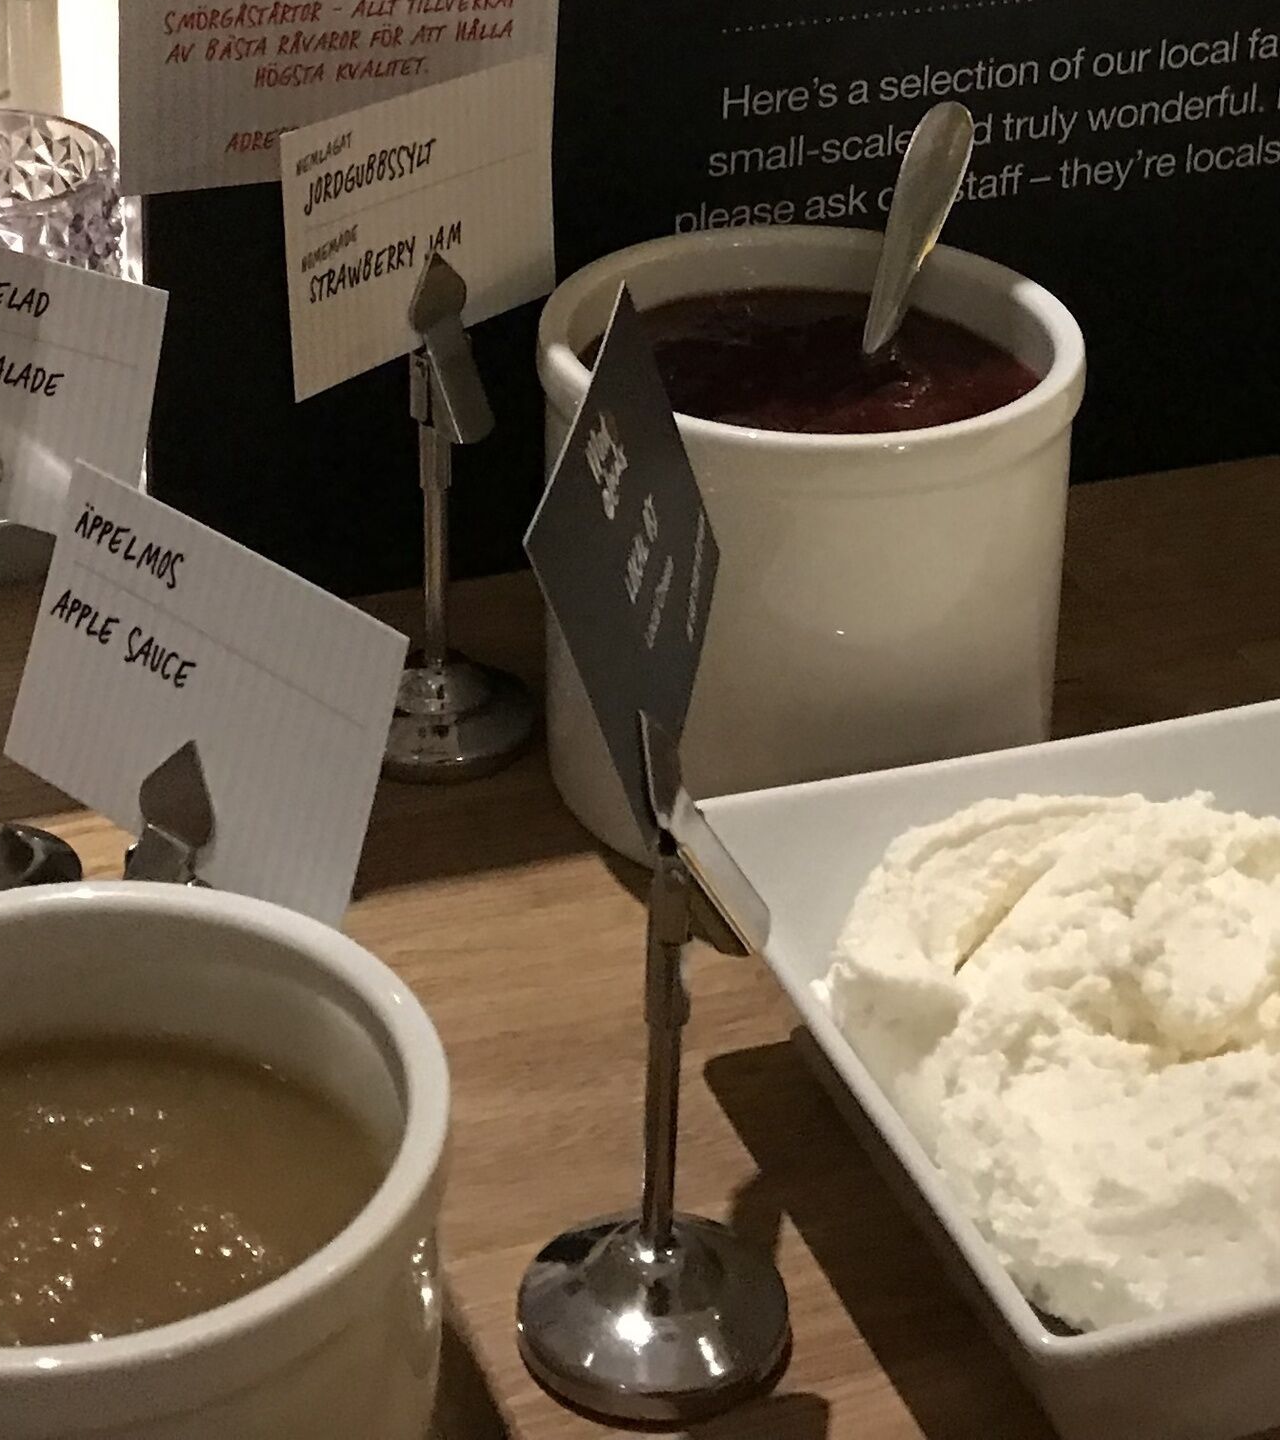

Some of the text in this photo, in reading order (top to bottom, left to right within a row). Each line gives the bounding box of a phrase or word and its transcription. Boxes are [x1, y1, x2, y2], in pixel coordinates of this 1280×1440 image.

[164, 1, 322, 35] SMÖRGÅSTÅRTOR
[165, 18, 513, 64] AV BÄSTA RÅVAROR FÖR ATT HÅLLA
[255, 56, 429, 88] HÖGSTA KVALITET.
[848, 81, 870, 106] a
[878, 57, 1039, 102] selection
[1049, 48, 1086, 82] of
[1092, 46, 1151, 79] our
[1159, 32, 1240, 70] local
[225, 127, 300, 153] ADRE
[707, 124, 915, 177] small-scale
[1003, 108, 1079, 145] truly
[1086, 84, 1265, 132] wonderful.
[304, 138, 436, 216] JORDGUBBSSYLT
[674, 197, 795, 236] please
[805, 184, 869, 220] ask
[309, 236, 416, 304] STRAWBERRY
[75, 502, 184, 589] ÄPPELMOS
[51, 589, 196, 688] APPLE SAUCE
